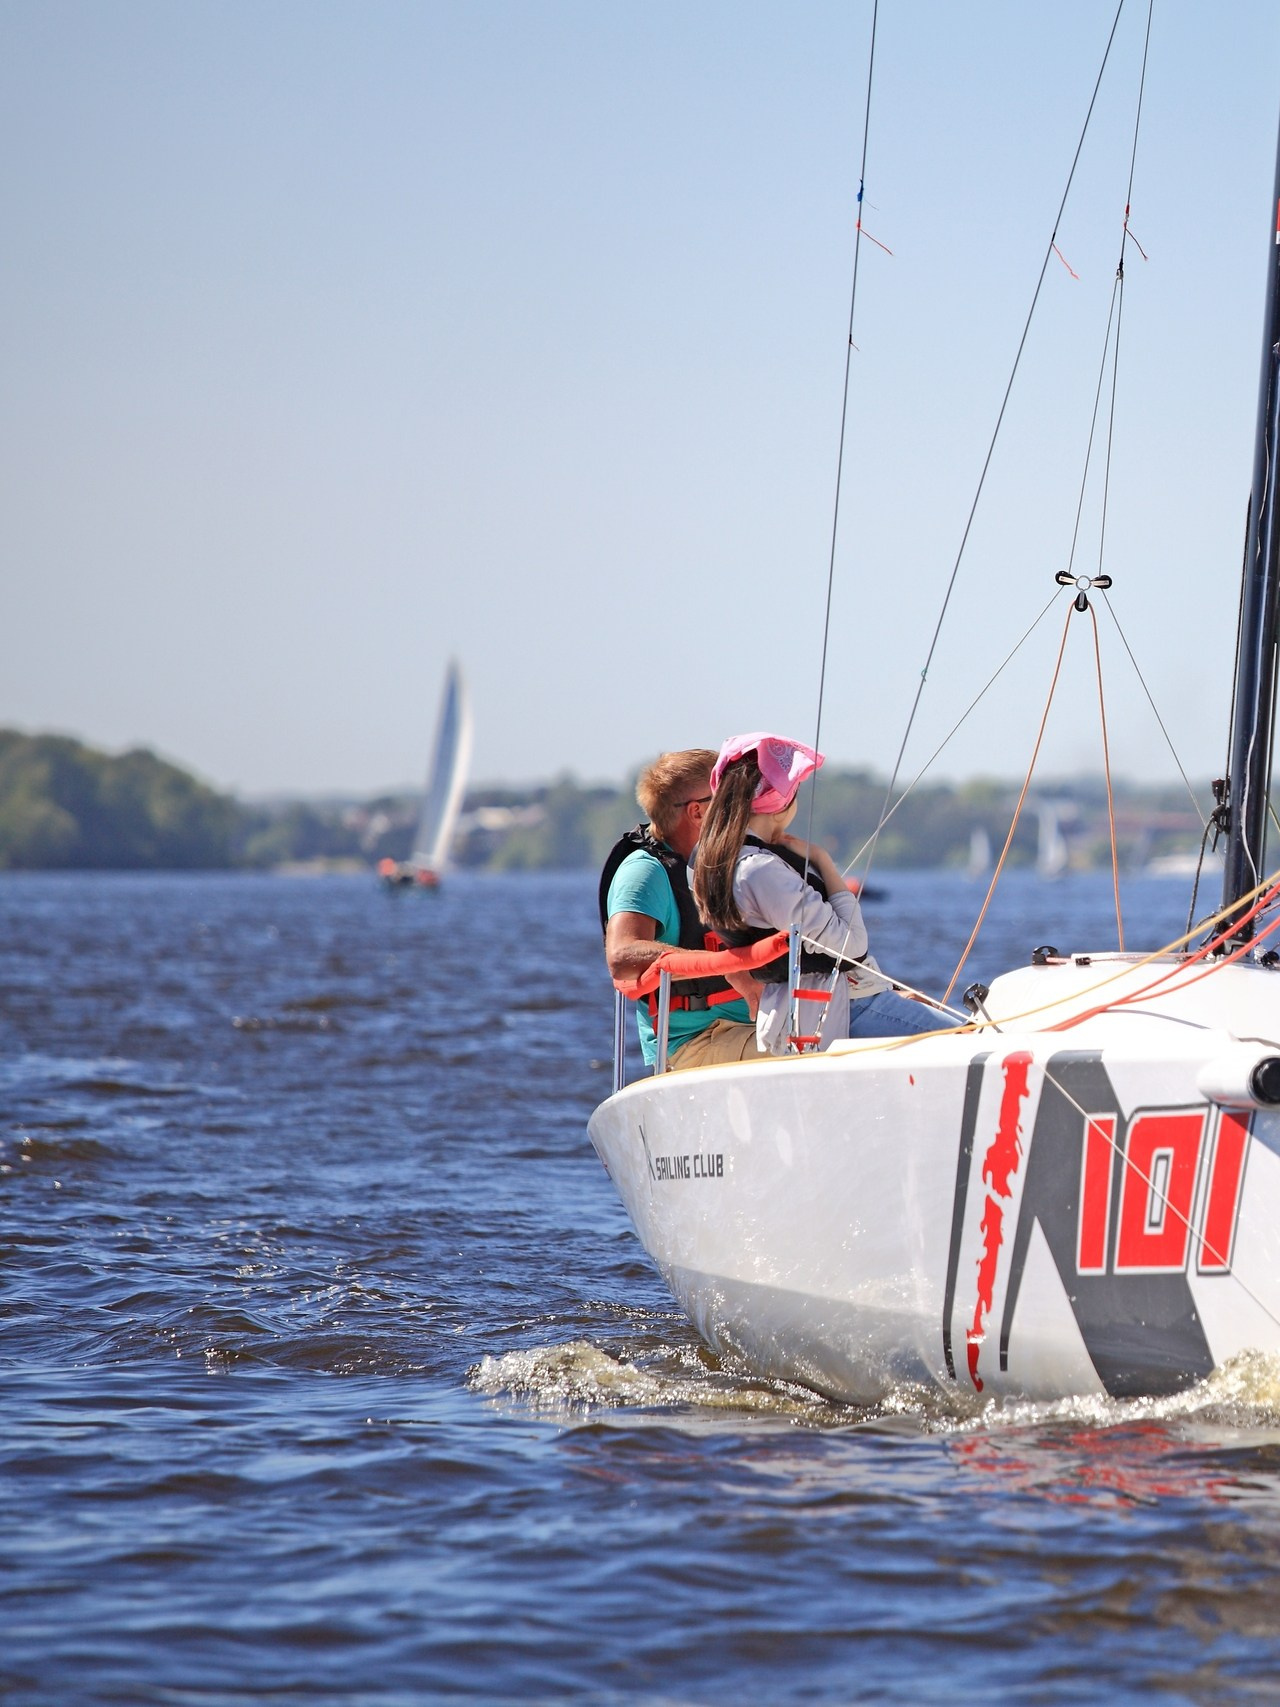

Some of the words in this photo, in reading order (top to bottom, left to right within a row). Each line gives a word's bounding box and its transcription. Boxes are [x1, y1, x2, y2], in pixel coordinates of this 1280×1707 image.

[656, 1154, 690, 1181] SAILING
[693, 1154, 723, 1178] CLUB
[1077, 1106, 1253, 1274] 101
